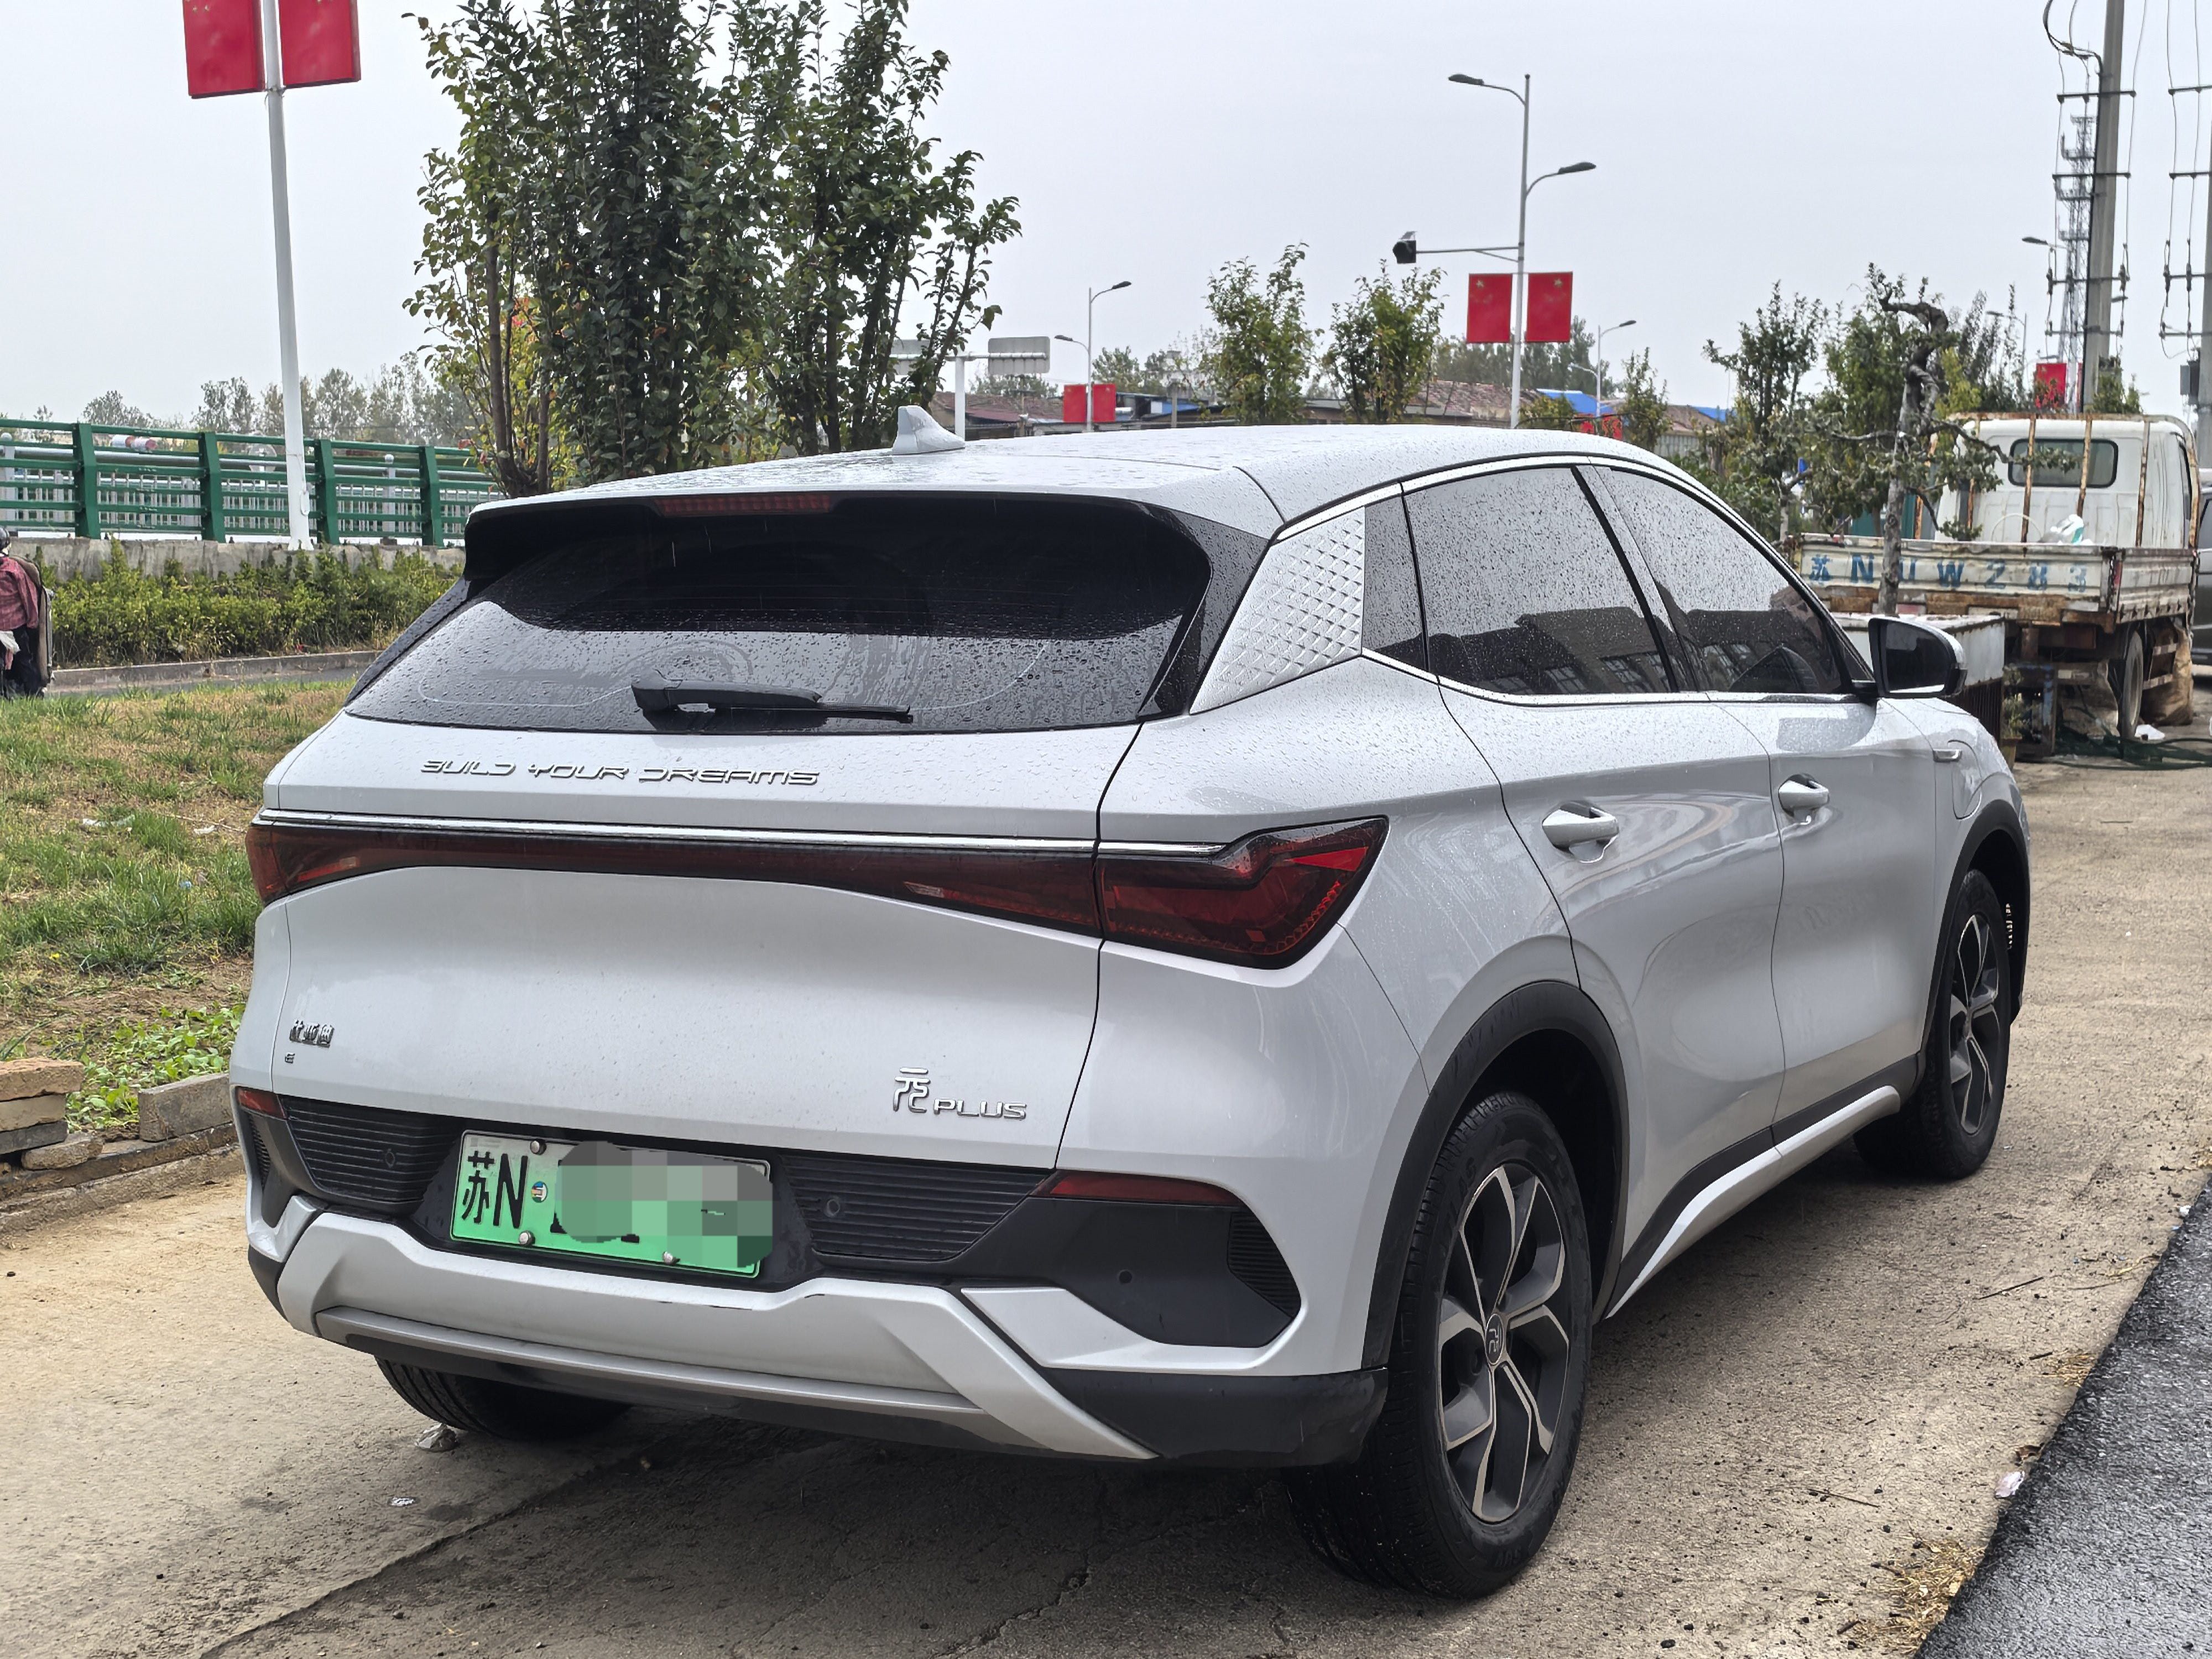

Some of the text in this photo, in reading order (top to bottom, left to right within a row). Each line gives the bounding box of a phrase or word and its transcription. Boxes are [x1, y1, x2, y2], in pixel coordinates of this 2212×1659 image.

[420, 759, 820, 785] BUILD YOUR DREAMS
[933, 1097, 1027, 1121] PLUS
